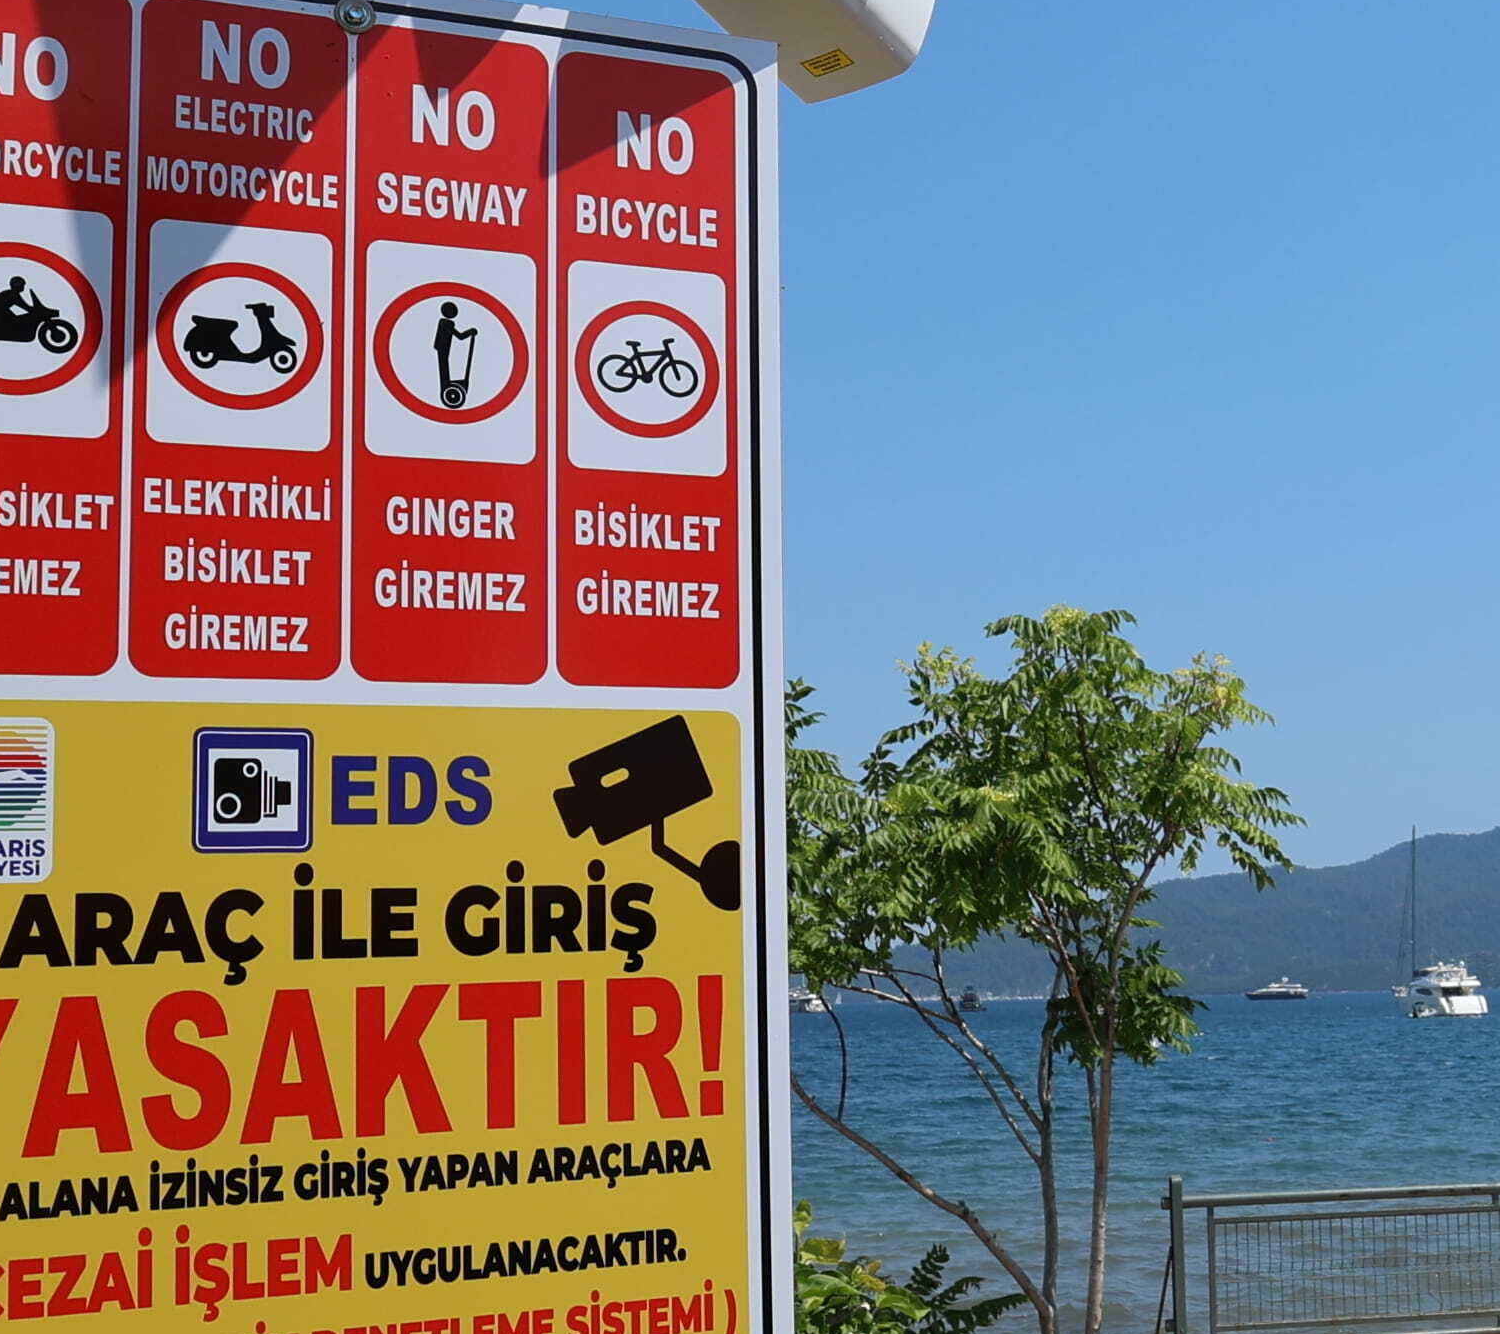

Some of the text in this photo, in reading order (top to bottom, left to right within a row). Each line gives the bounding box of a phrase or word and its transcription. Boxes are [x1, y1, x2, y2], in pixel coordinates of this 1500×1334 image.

[202, 20, 289, 88] NO
[176, 95, 313, 143] ELECTRIC
[412, 84, 495, 150] NO
[617, 111, 694, 175] NO
[147, 156, 338, 208] MOTORCYCLE
[377, 172, 527, 226] SEGWAY
[577, 194, 717, 247] BICYCLE
[144, 476, 330, 521] ELEKTRİKLİ
[387, 496, 515, 539] GINGER
[575, 502, 720, 551] BİSİKLET
[165, 538, 311, 585] BİSİKLET
[375, 568, 525, 611] GİREMEZ
[577, 570, 719, 618] GİREMEZ
[165, 605, 308, 652] GİREMEZ
[331, 756, 492, 825] EDS
[294, 863, 418, 960] İLE
[445, 859, 656, 972] GİRİŞ
[150, 1155, 283, 1210] İZİNSİZ
[294, 1148, 389, 1206] GİRİŞ
[398, 1151, 517, 1192] YAPAN
[528, 1139, 711, 1188] ARAÇLARA
[175, 1225, 352, 1322] İŞLEM
[366, 1229, 686, 1289] UYGULANACAKTIR.
